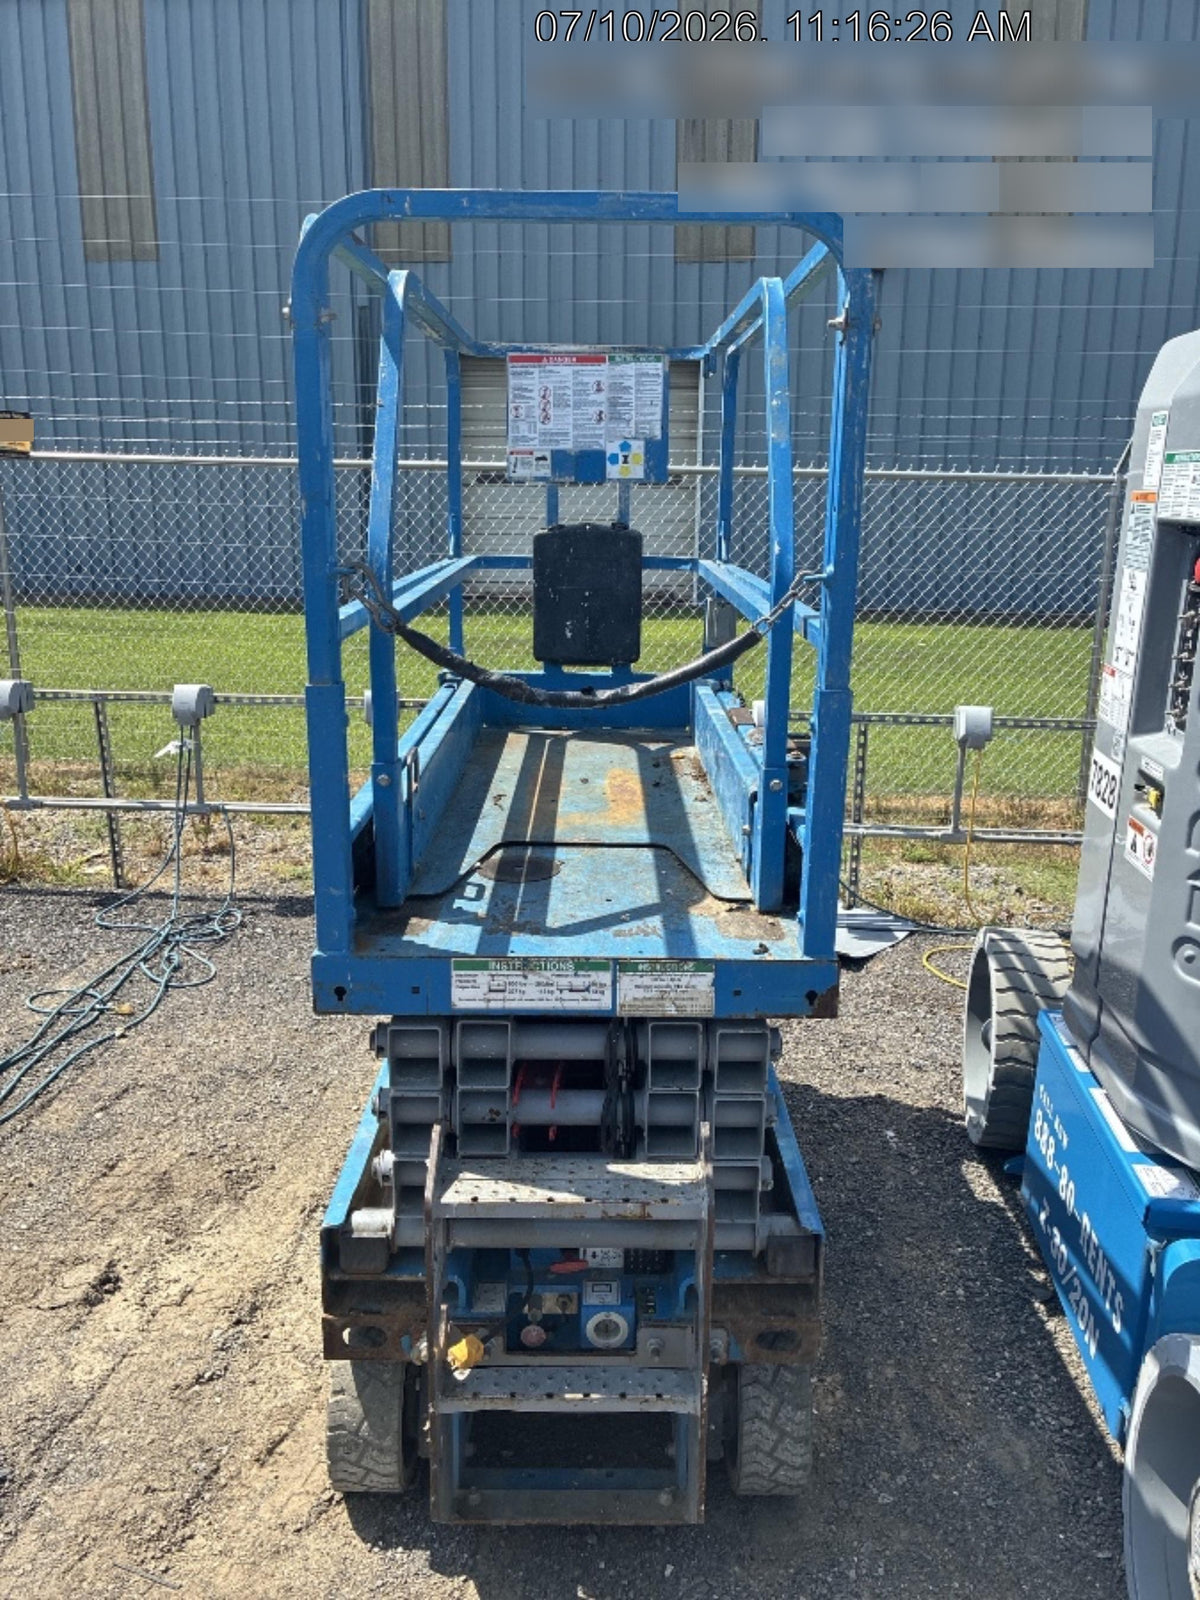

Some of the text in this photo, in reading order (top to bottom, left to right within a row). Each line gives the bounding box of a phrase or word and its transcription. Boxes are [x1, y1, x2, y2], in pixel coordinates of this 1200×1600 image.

[1091, 759, 1118, 810] 7828
[488, 960, 575, 971] INSTRCTIONS
[1034, 1109, 1124, 1334] 888-80-RENTS
